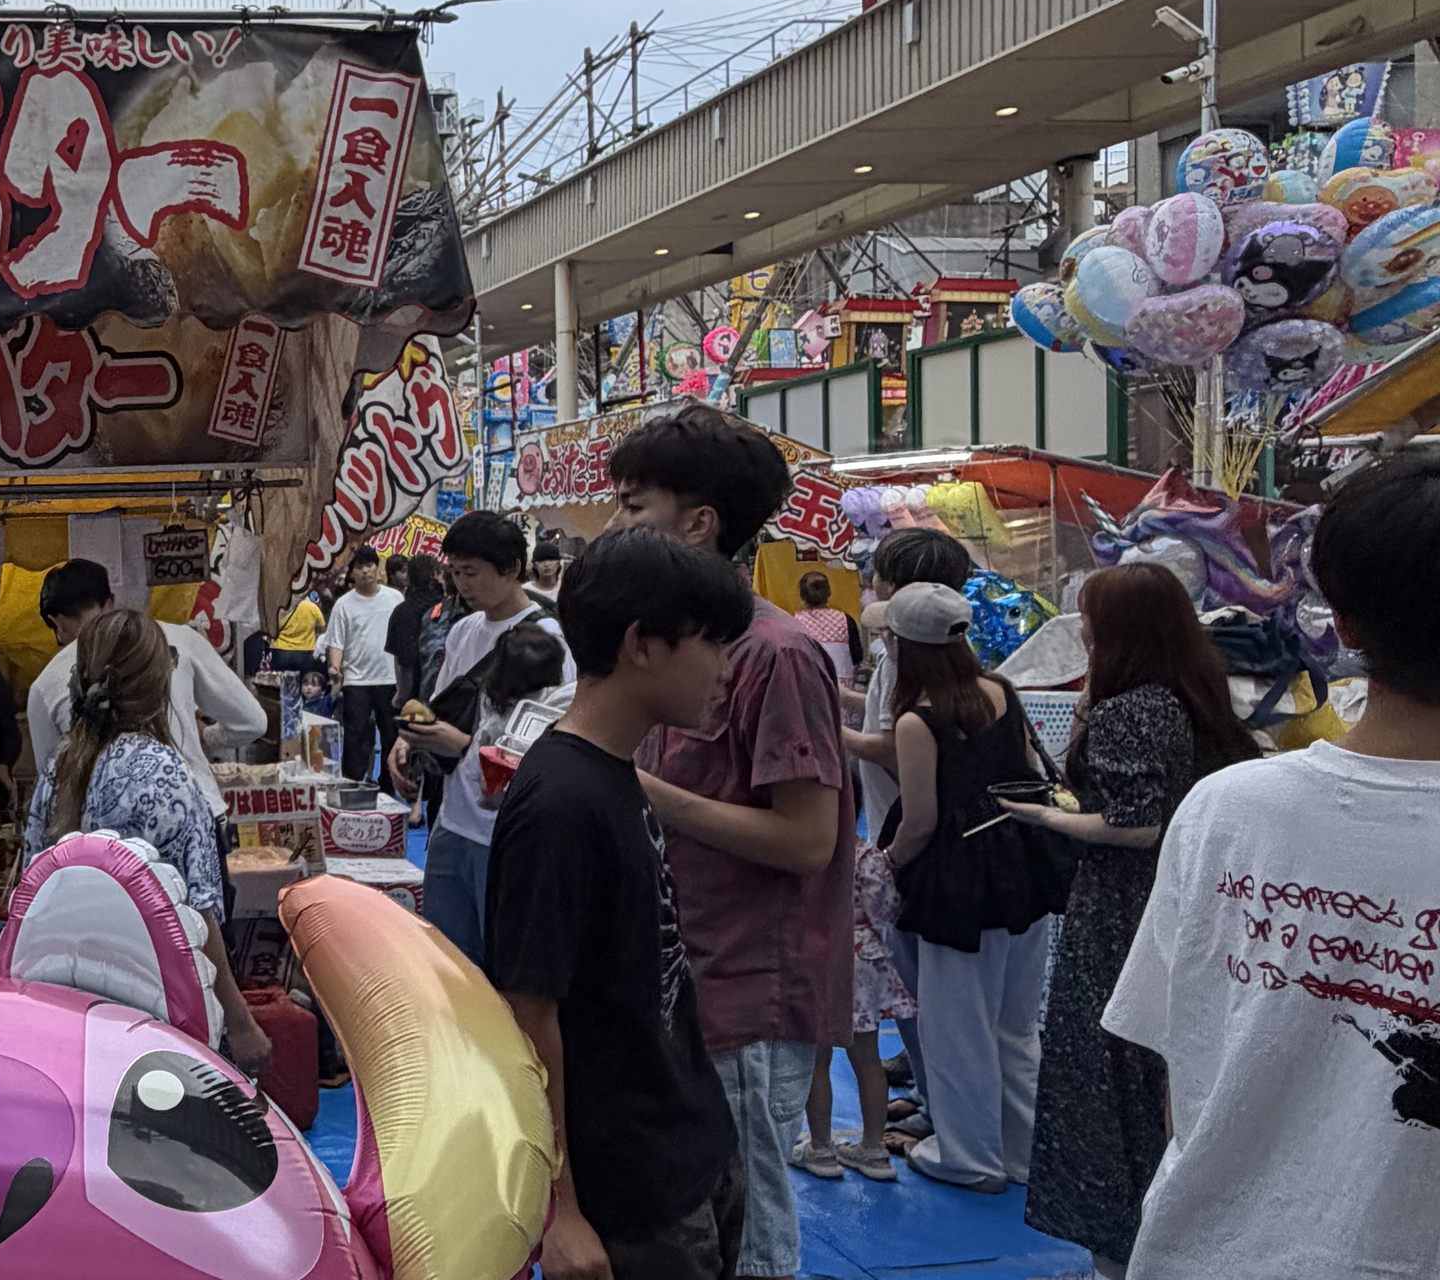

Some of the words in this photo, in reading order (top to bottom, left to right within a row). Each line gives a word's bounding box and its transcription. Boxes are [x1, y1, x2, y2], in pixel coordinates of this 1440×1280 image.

[317, 93, 400, 267] 一食入魂
[222, 319, 277, 431] 一食入魂
[1261, 881, 1404, 928] perfect
[1307, 933, 1435, 986] partner
